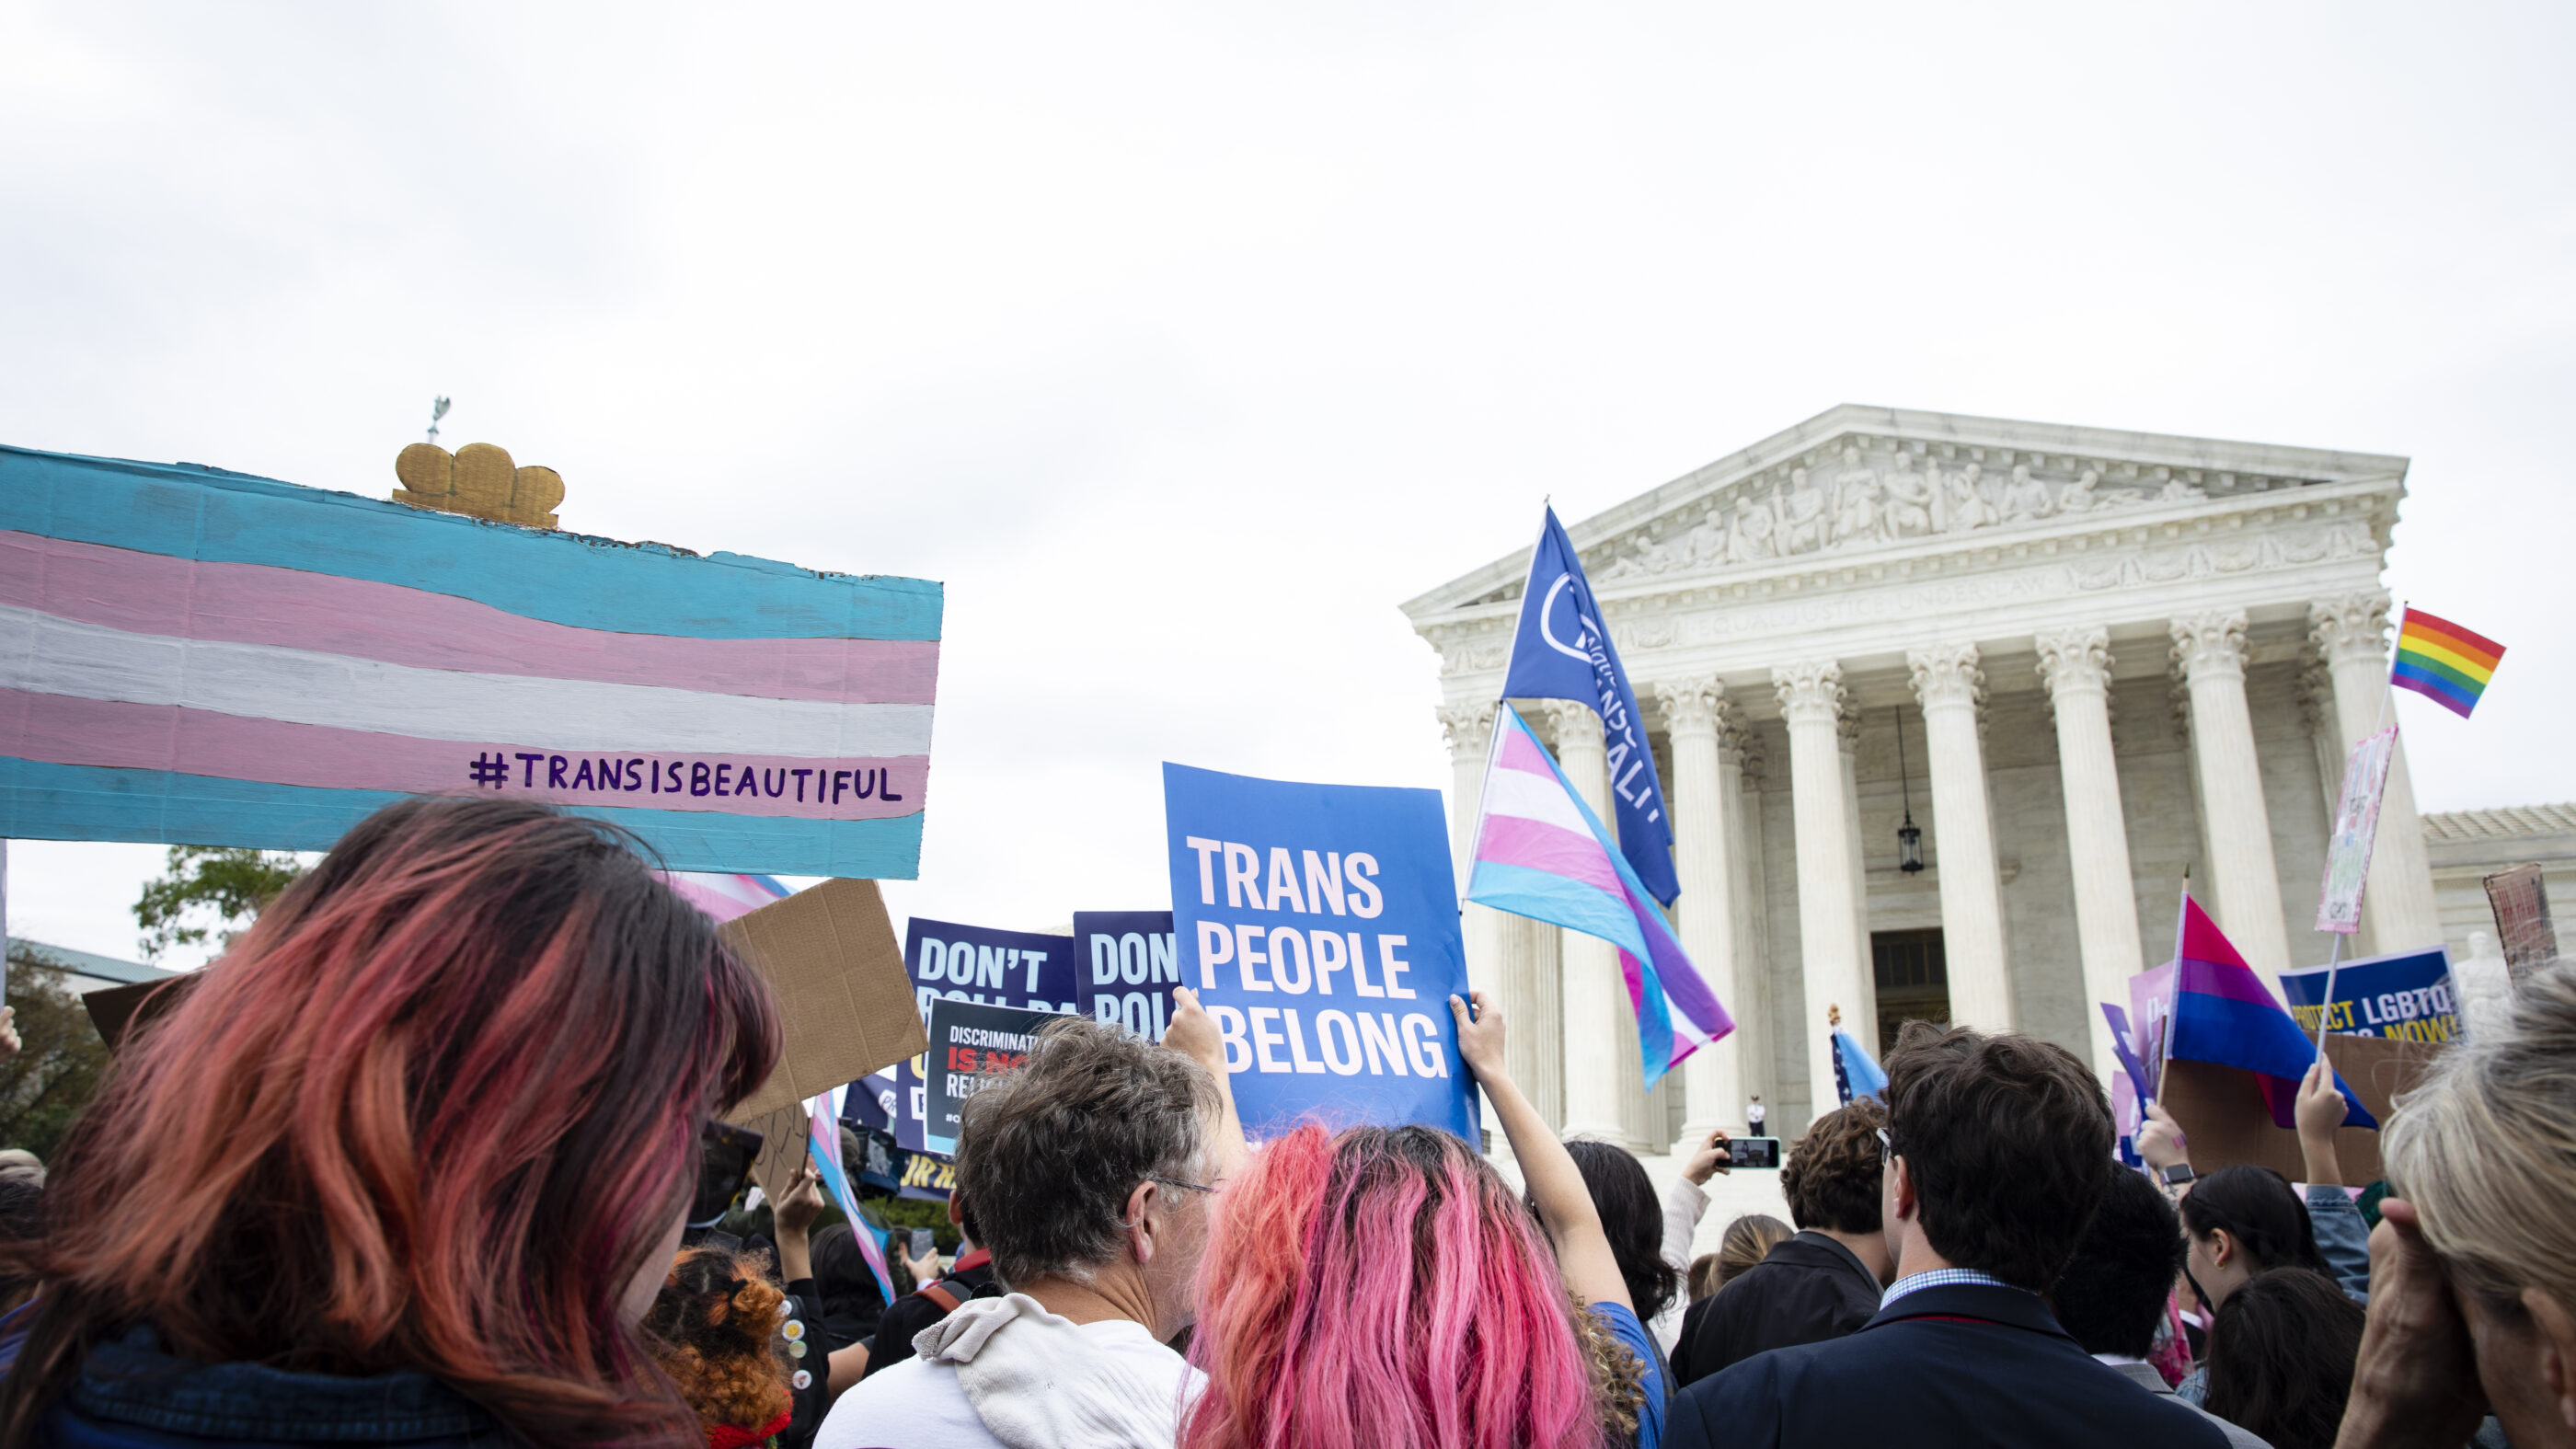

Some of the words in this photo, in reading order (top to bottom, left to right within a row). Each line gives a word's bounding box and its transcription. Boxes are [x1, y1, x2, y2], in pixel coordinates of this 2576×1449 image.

[1699, 614, 1780, 637] EQUAL
[1787, 596, 1885, 627] JUSTICE
[1898, 583, 1988, 610] UNDER
[1995, 574, 2048, 598] LAW
[469, 751, 903, 806] #TRANSISBEAUTIFUL
[1187, 835, 1384, 920] TRANS
[917, 937, 1047, 993] DON'T
[1197, 920, 1417, 1000] PEOPLE
[2362, 985, 2453, 1025] LGBTQ
[2384, 1015, 2459, 1043] NOW!
[948, 1046, 978, 1073] IS
[1205, 1005, 1448, 1079] BELONG
